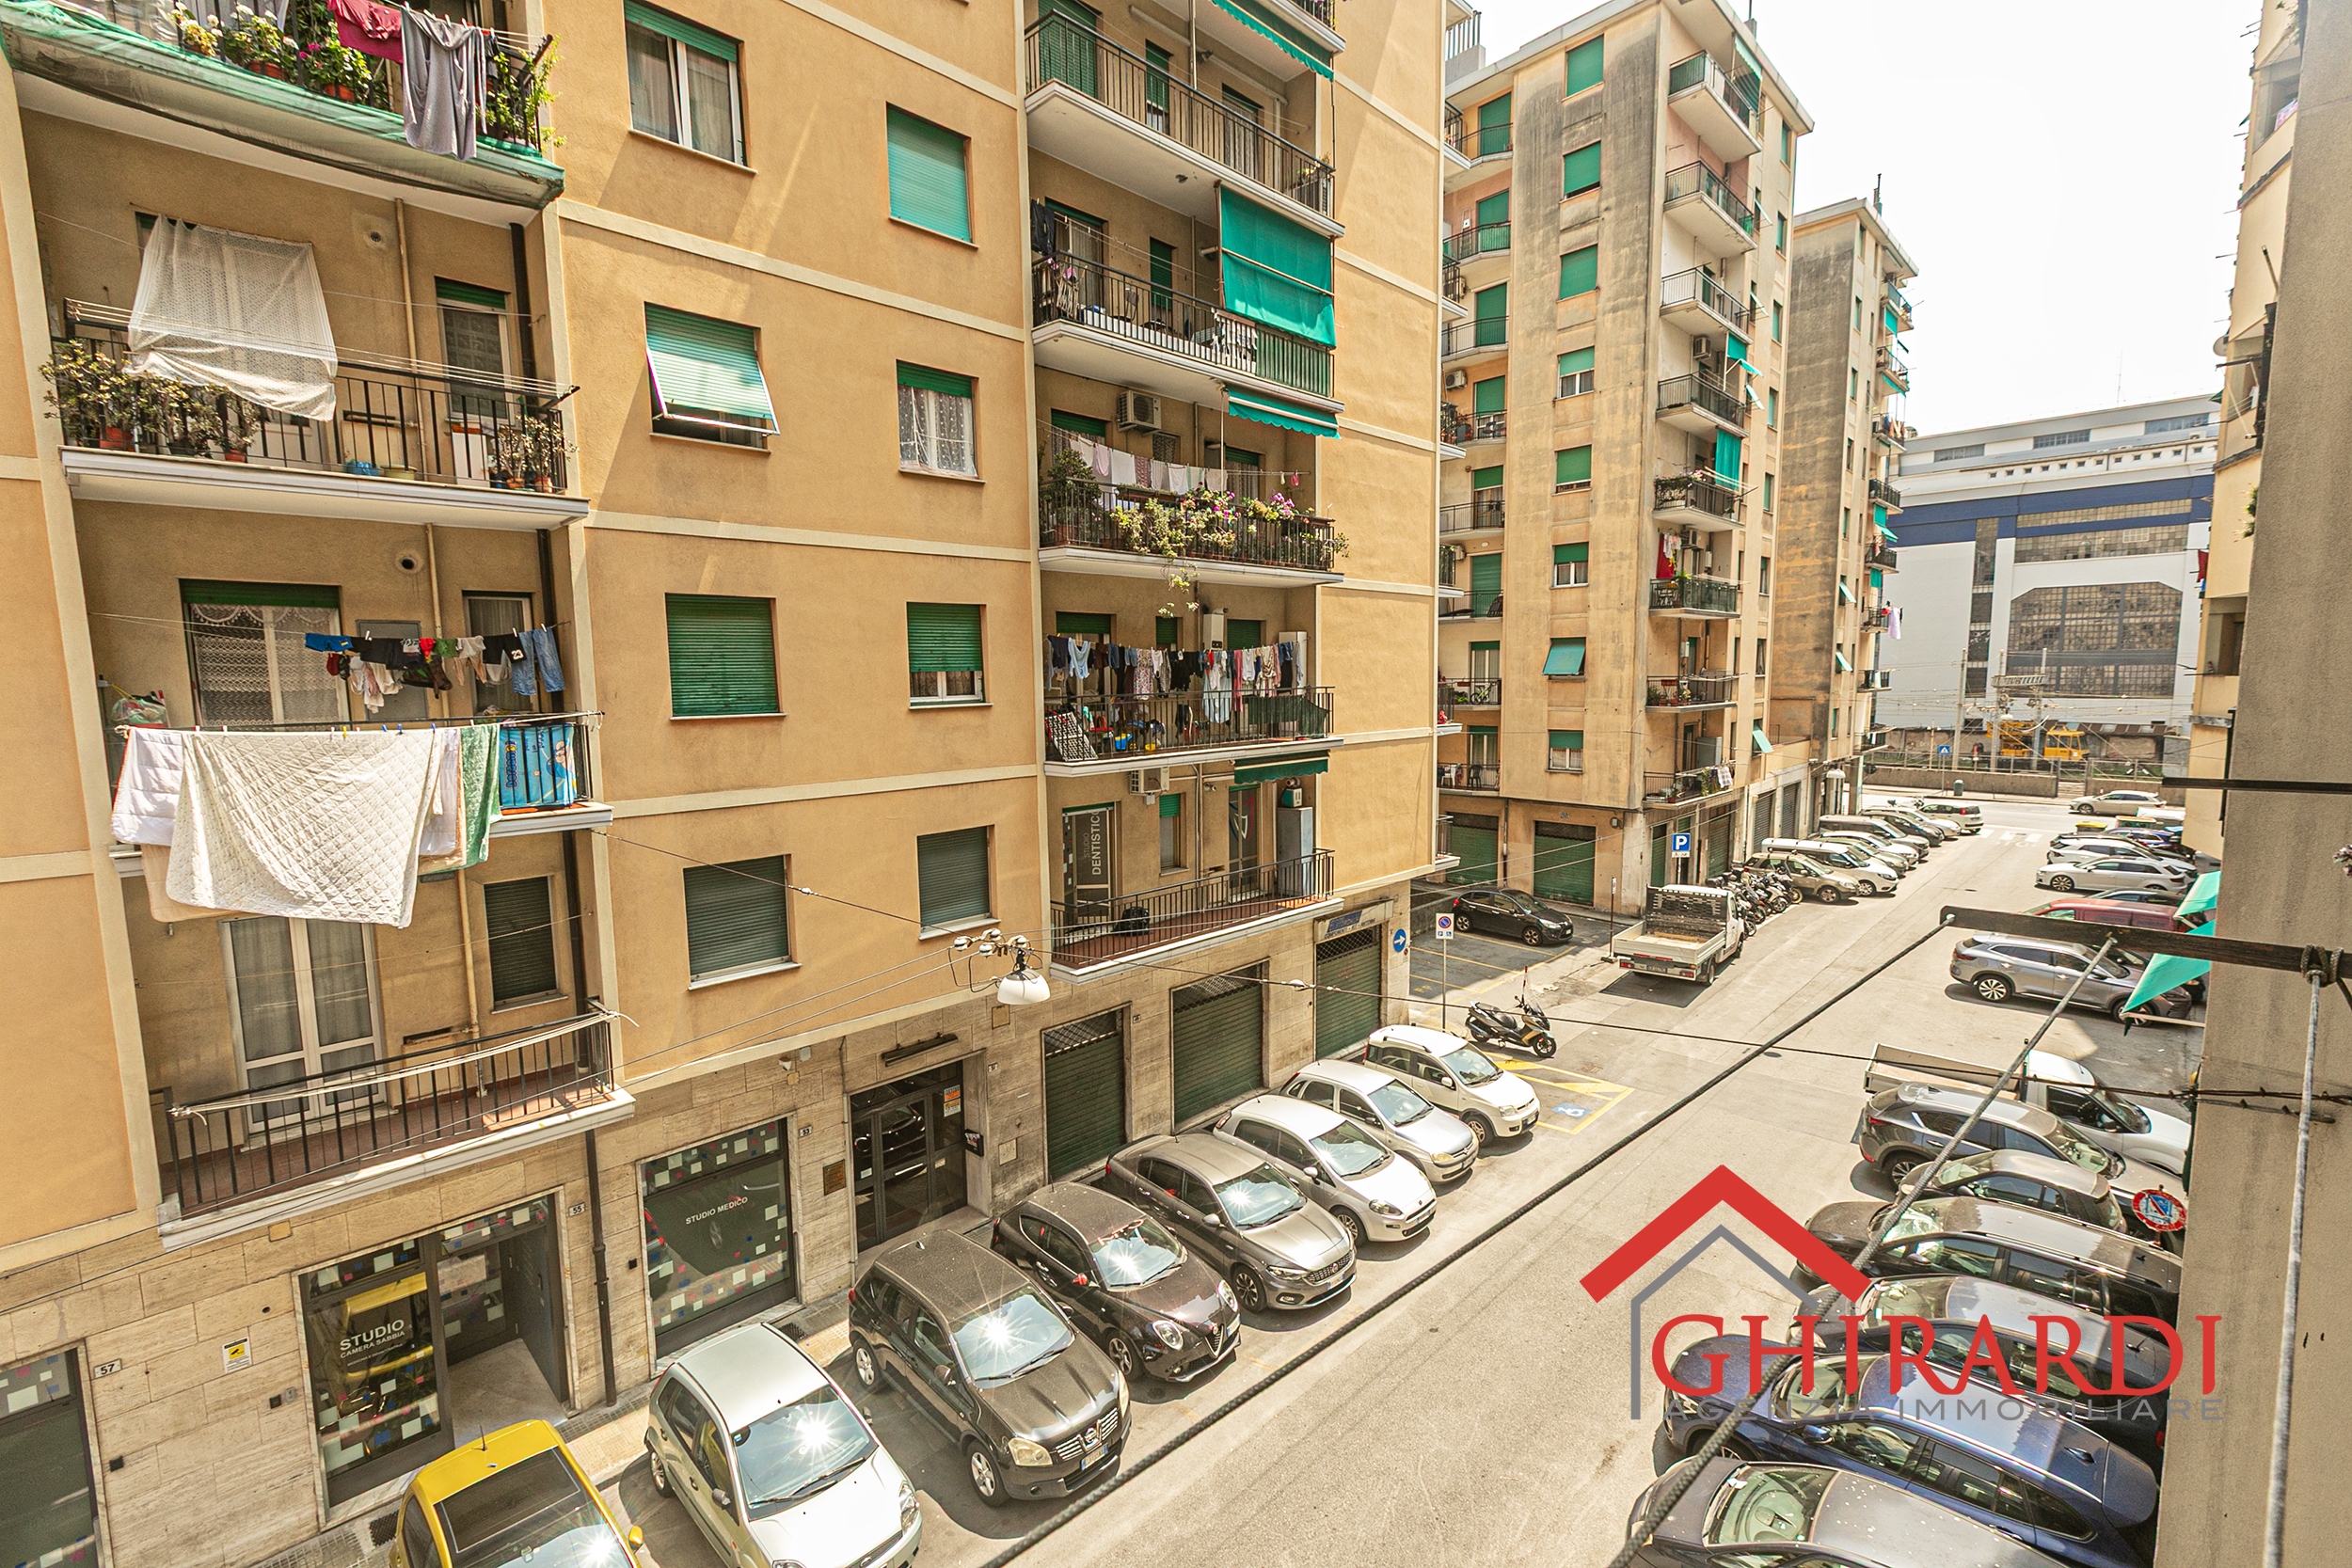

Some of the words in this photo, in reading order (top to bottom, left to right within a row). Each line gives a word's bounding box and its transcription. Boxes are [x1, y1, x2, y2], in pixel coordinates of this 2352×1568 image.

[511, 649, 524, 660] 23
[1676, 835, 1688, 850] P
[572, 1206, 582, 1214] 55
[685, 1208, 716, 1225] STUDIO
[717, 1196, 749, 1213] MEDICO
[340, 1319, 405, 1351] STUDIO
[340, 1341, 375, 1358] CAMERA
[375, 1331, 405, 1346] SABBIA
[100, 1363, 116, 1375] 57
